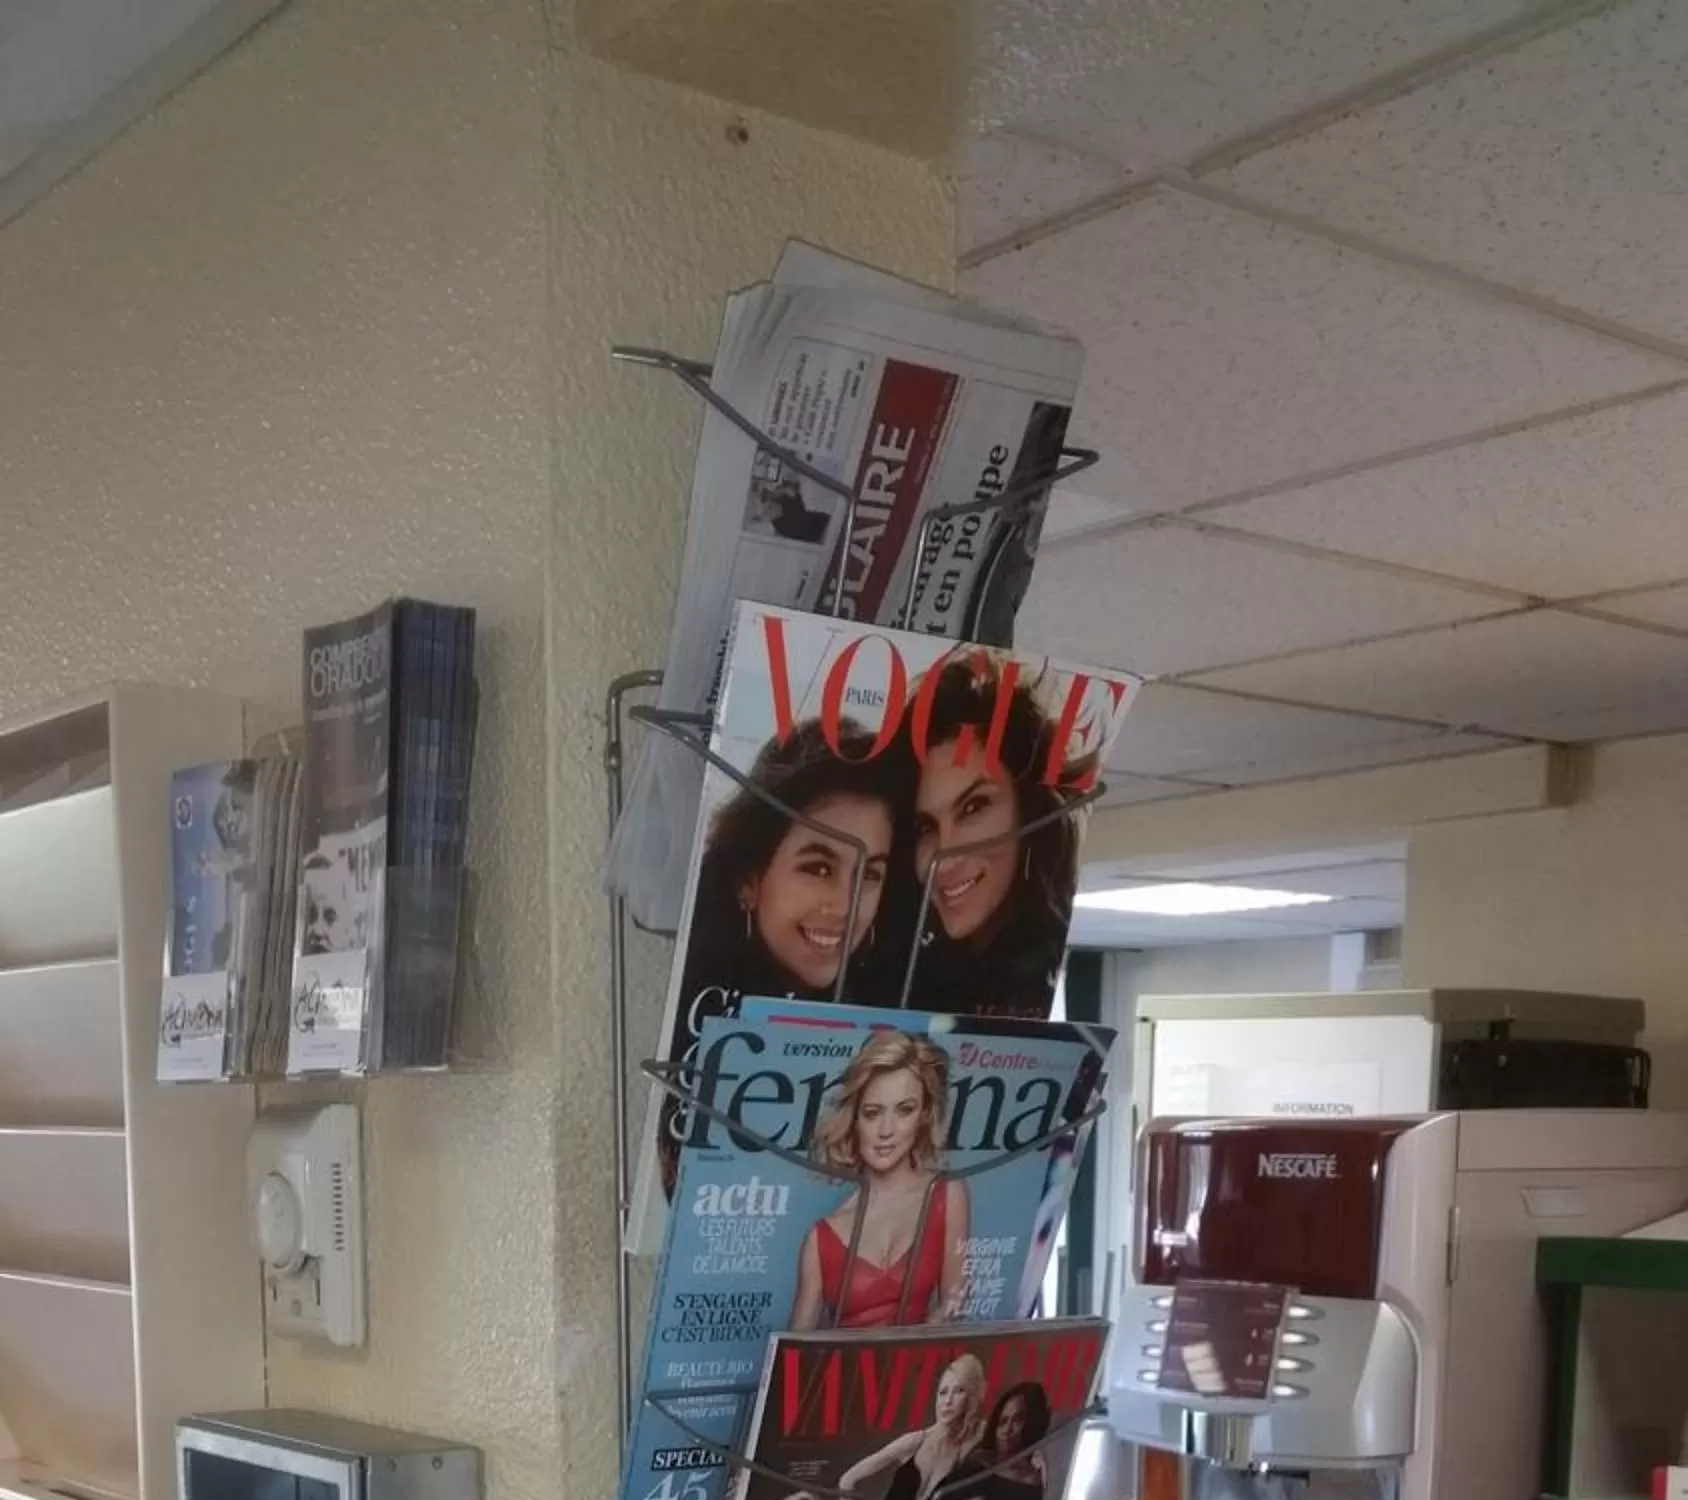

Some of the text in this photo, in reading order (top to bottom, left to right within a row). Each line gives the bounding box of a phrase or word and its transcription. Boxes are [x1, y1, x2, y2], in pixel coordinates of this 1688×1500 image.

[753, 613, 1128, 791] VOGUE
[845, 686, 887, 705] PARIS
[783, 1037, 853, 1058] version
[684, 1031, 1054, 1153] fena
[1258, 1153, 1339, 1178] NESCAFÉ
[692, 1175, 791, 1217] actu
[780, 1343, 967, 1440] VANIT
